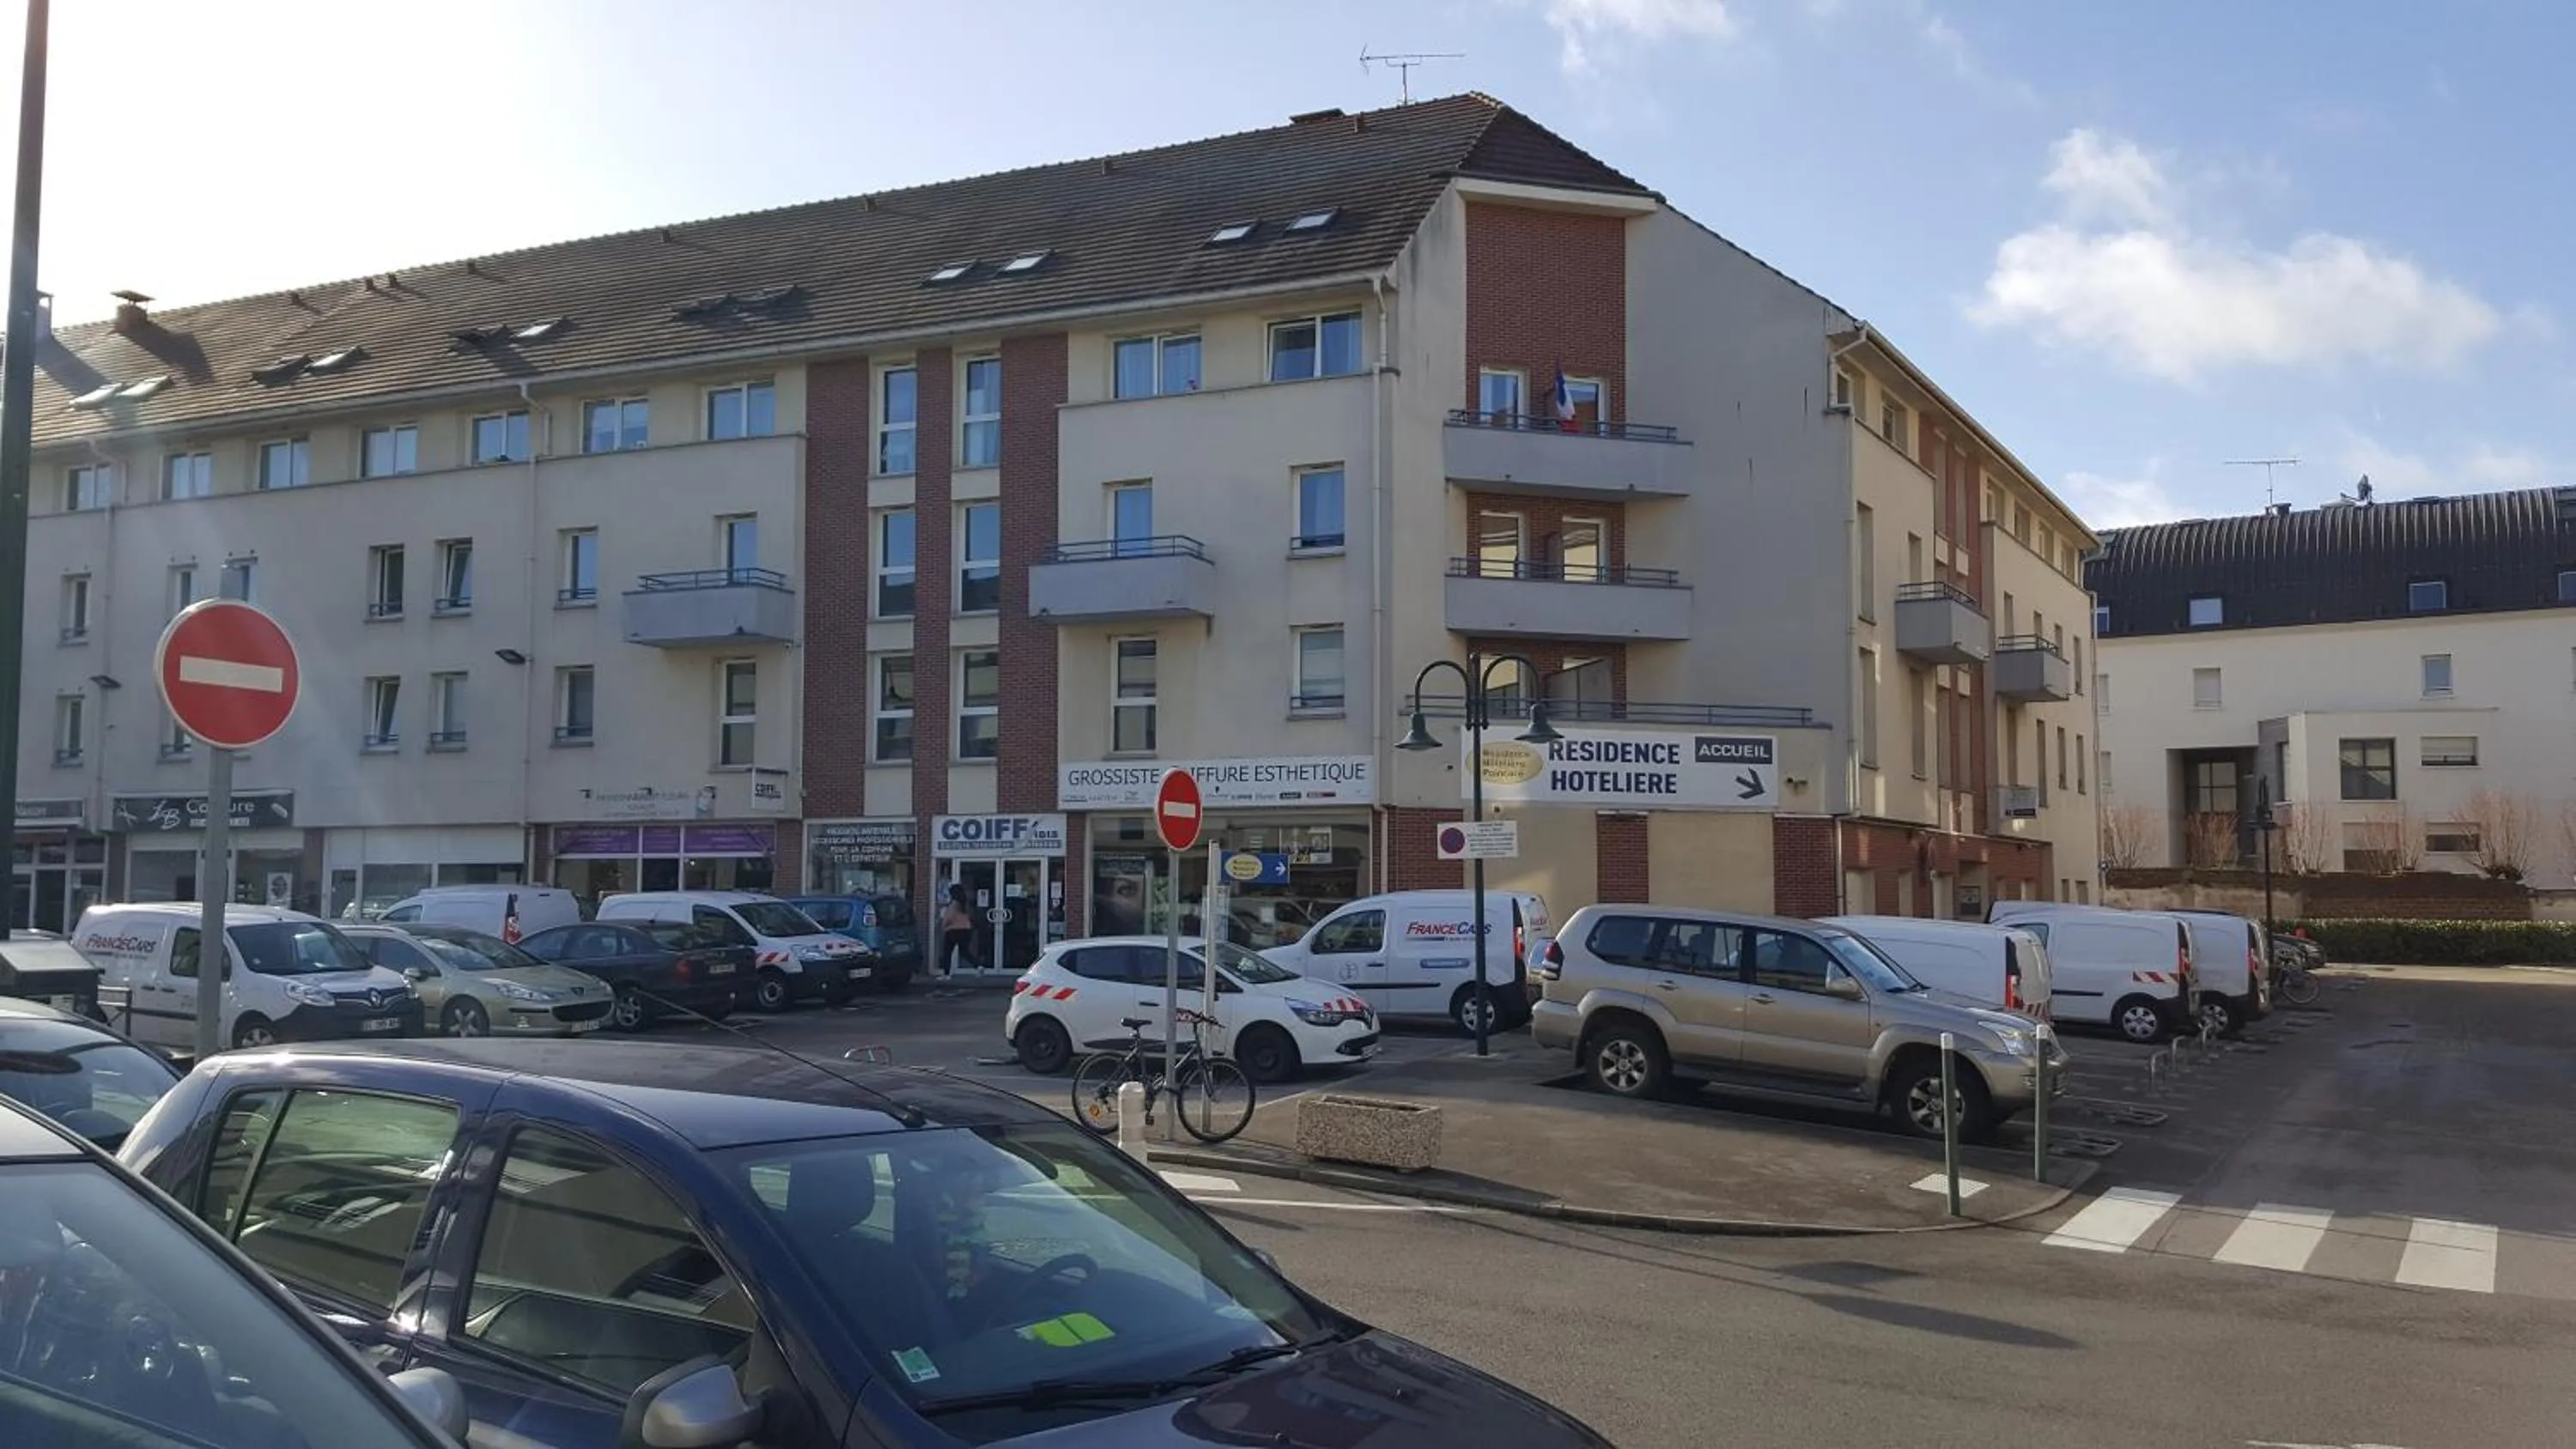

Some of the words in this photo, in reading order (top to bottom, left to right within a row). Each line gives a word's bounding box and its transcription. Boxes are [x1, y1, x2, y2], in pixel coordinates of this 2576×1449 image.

[1548, 740, 1680, 765] RESIDENCE
[1698, 743, 1770, 759] ACCUEIL
[1067, 768, 1160, 785] GROSSISTE
[1254, 762, 1367, 784] ESTHETIQUE
[1551, 770, 1677, 794] HOTELIERE
[185, 798, 255, 814] Coure
[1406, 921, 1492, 936] FRANCECAS
